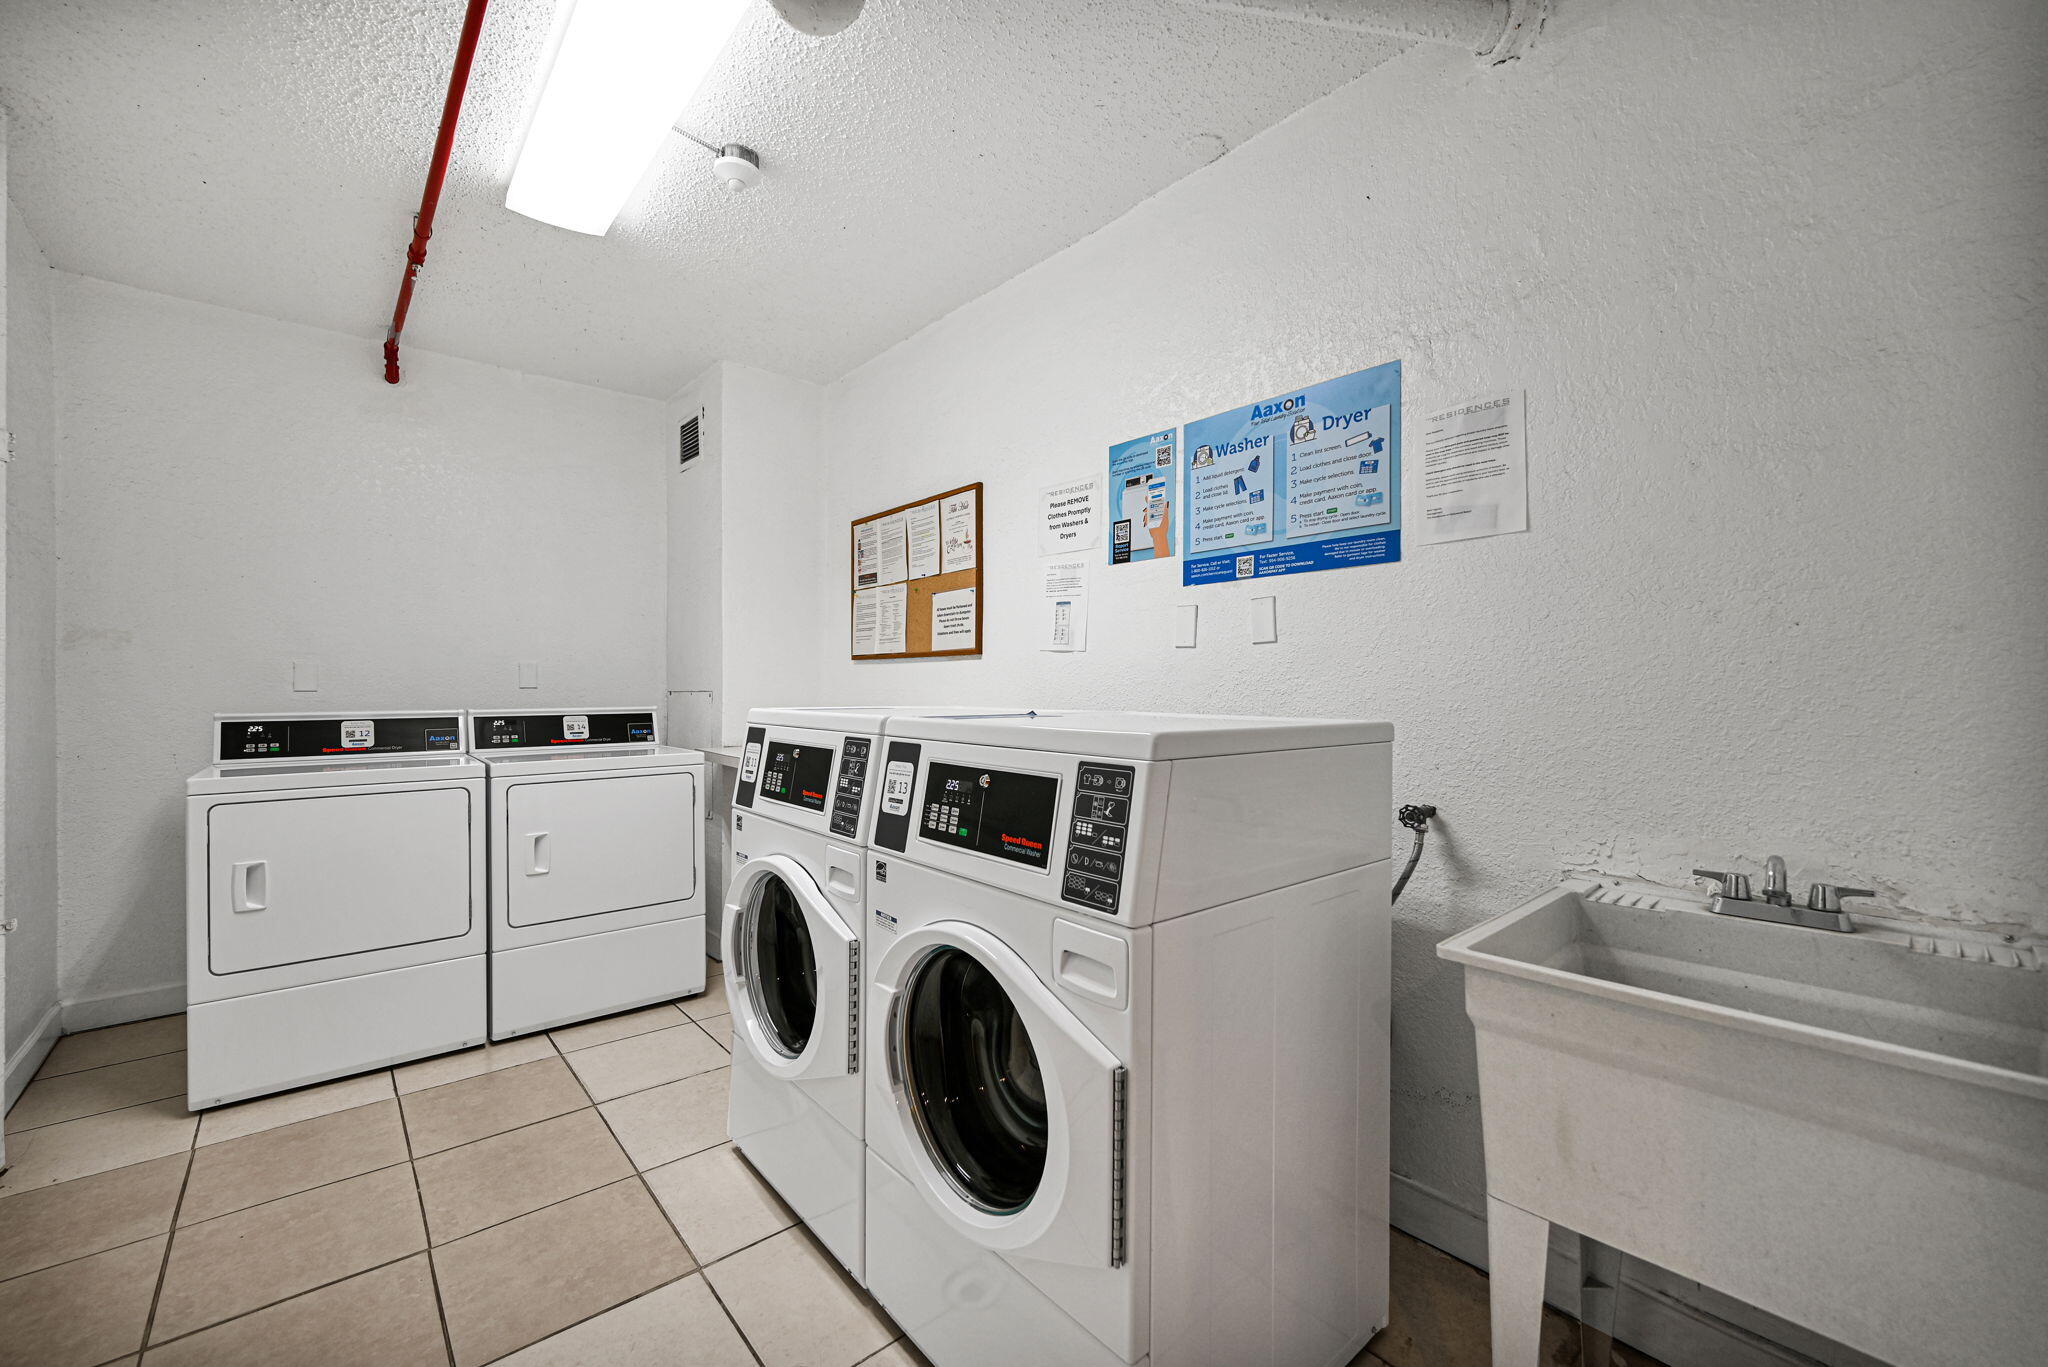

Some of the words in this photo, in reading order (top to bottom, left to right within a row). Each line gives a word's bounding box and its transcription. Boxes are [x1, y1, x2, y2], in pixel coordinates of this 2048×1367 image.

[1251, 395, 1306, 420] Aaxon
[1431, 398, 1510, 422] RESIDENCES
[1322, 408, 1372, 430] Dryer
[1216, 435, 1269, 457] Washer
[1067, 495, 1089, 505] REMOVE
[1048, 512, 1067, 520] Clothes
[1068, 507, 1092, 516] Promptly
[1062, 519, 1083, 528] Washers
[751, 758, 757, 767] 11
[898, 782, 908, 794] 13
[946, 780, 960, 790] 225
[1002, 833, 1021, 844] Speed
[1022, 838, 1042, 849] Queen
[1004, 843, 1025, 854] Commercial
